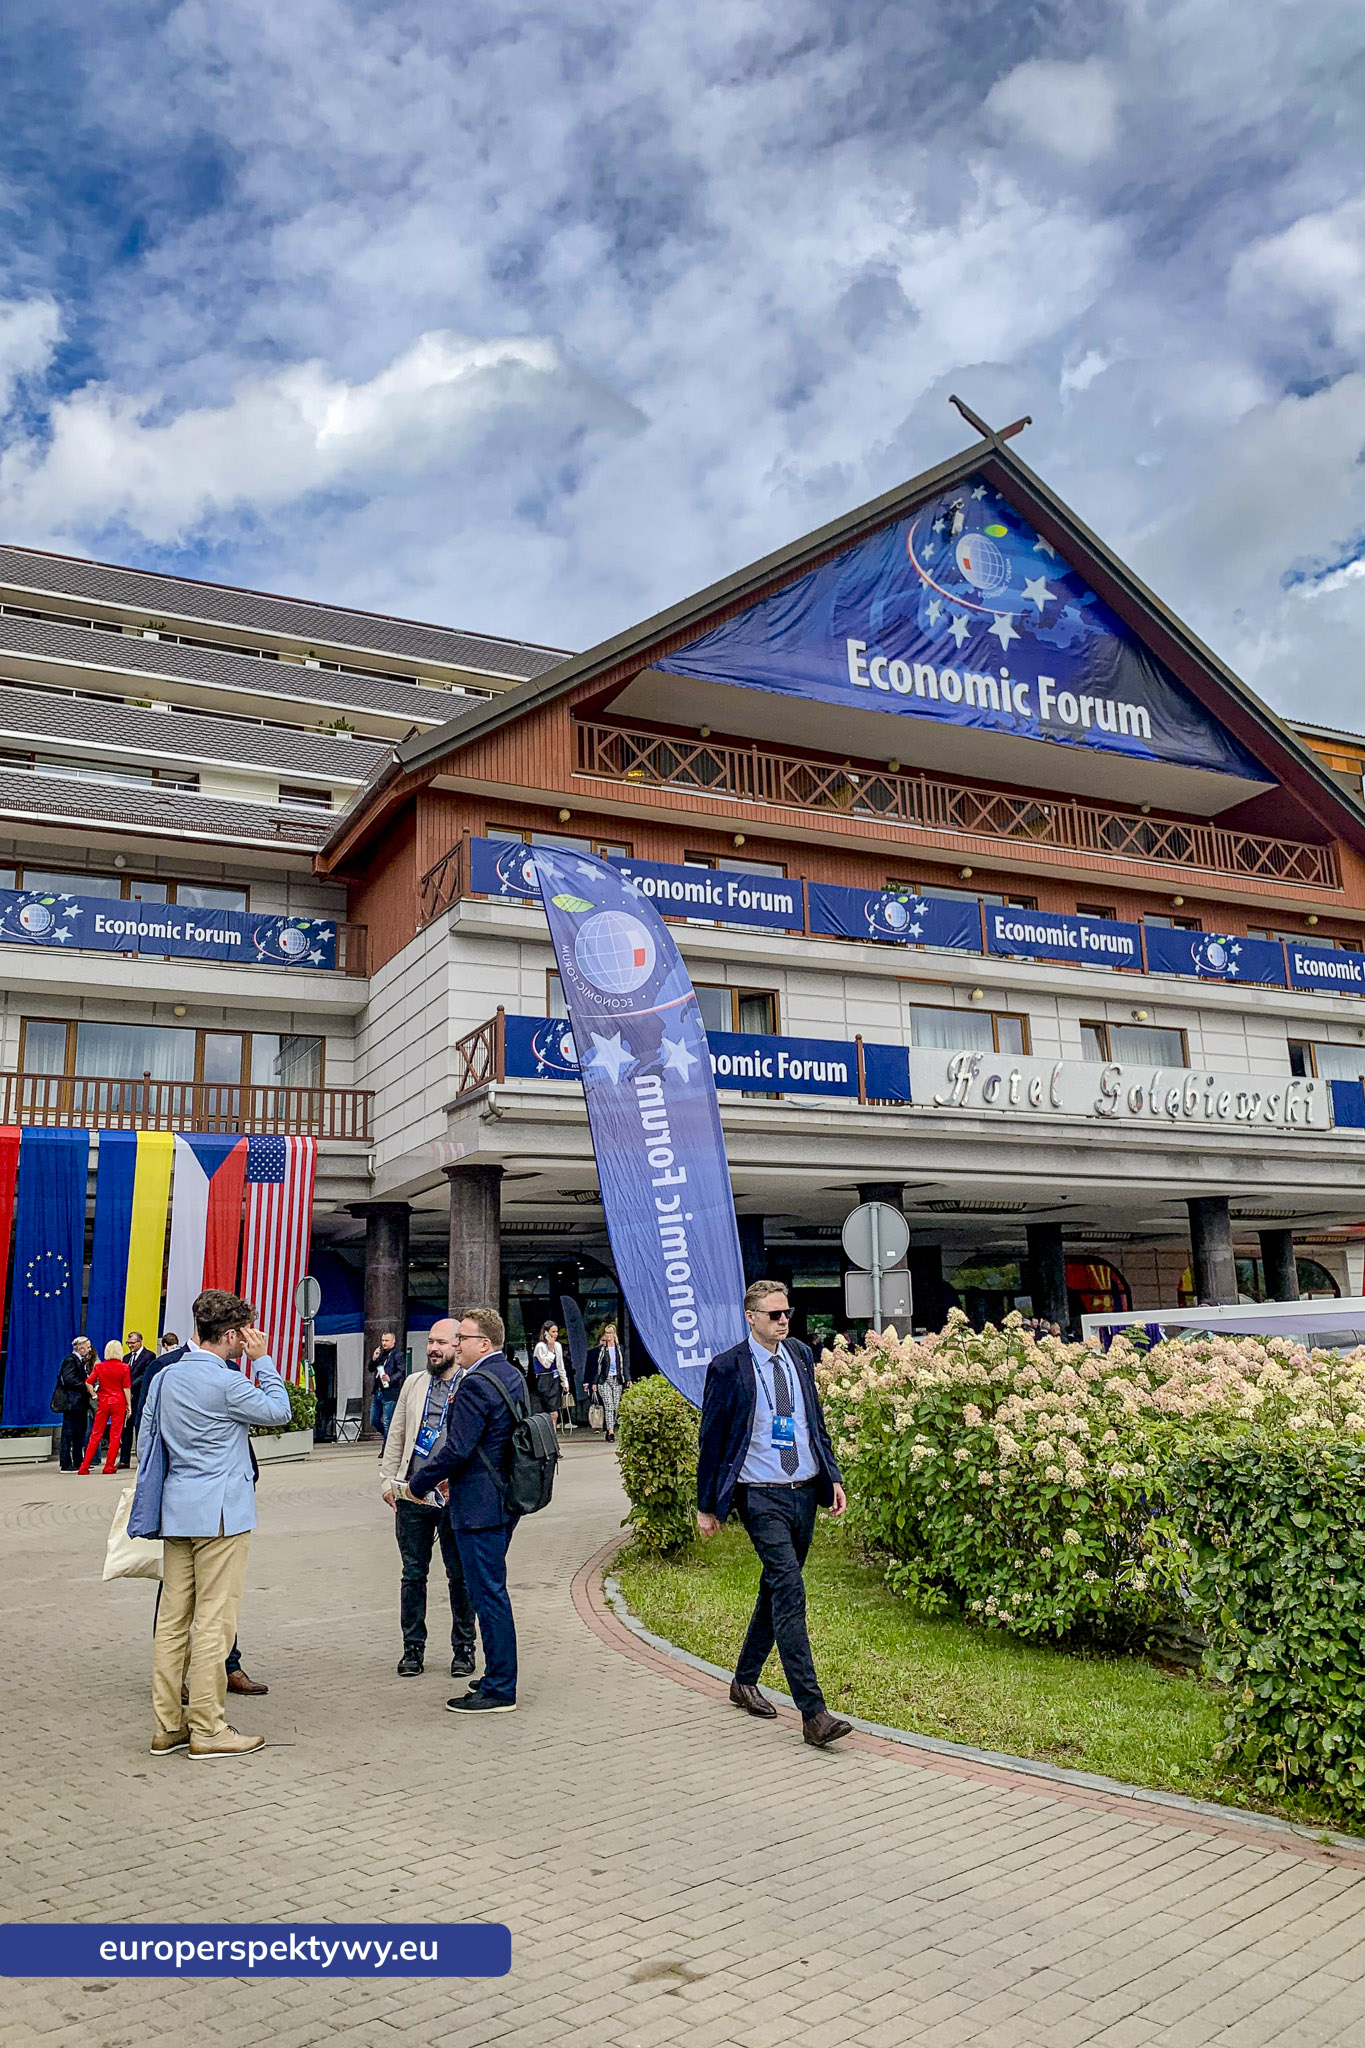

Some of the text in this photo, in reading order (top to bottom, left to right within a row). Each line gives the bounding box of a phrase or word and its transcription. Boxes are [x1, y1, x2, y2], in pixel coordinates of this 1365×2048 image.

[846, 637, 1153, 739] Economic Forum
[727, 882, 794, 914] Forum
[95, 914, 242, 945] Economic Forum
[994, 915, 1134, 955] Economic Forum
[1294, 953, 1362, 981] Economic
[777, 1052, 848, 1083] Forum
[934, 1051, 1064, 1108] Hotel
